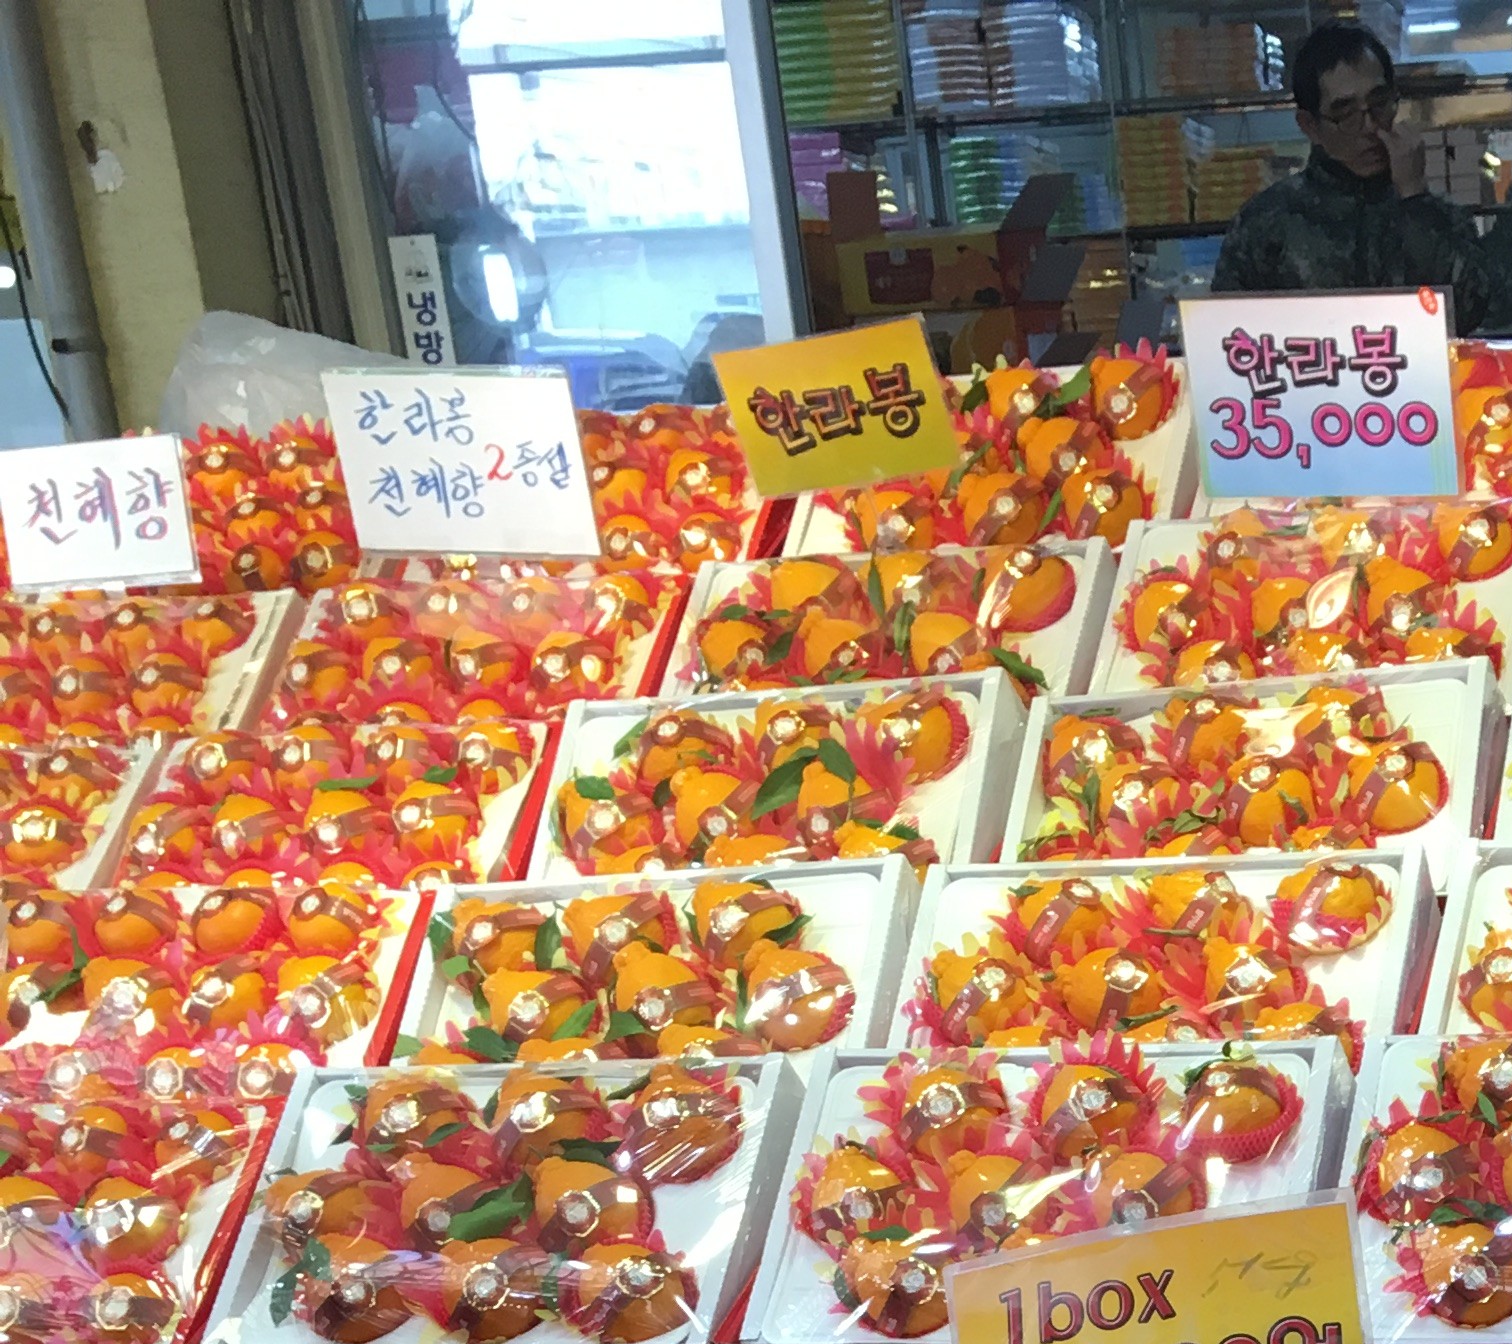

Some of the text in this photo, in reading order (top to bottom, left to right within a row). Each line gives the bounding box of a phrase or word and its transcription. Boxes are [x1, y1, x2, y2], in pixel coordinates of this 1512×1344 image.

[1222, 324, 1409, 398] 한라봉
[353, 386, 475, 446] 한라봉
[747, 362, 927, 457] 한라봉
[1209, 396, 1439, 469] 35,000
[22, 465, 175, 551] 천혜향
